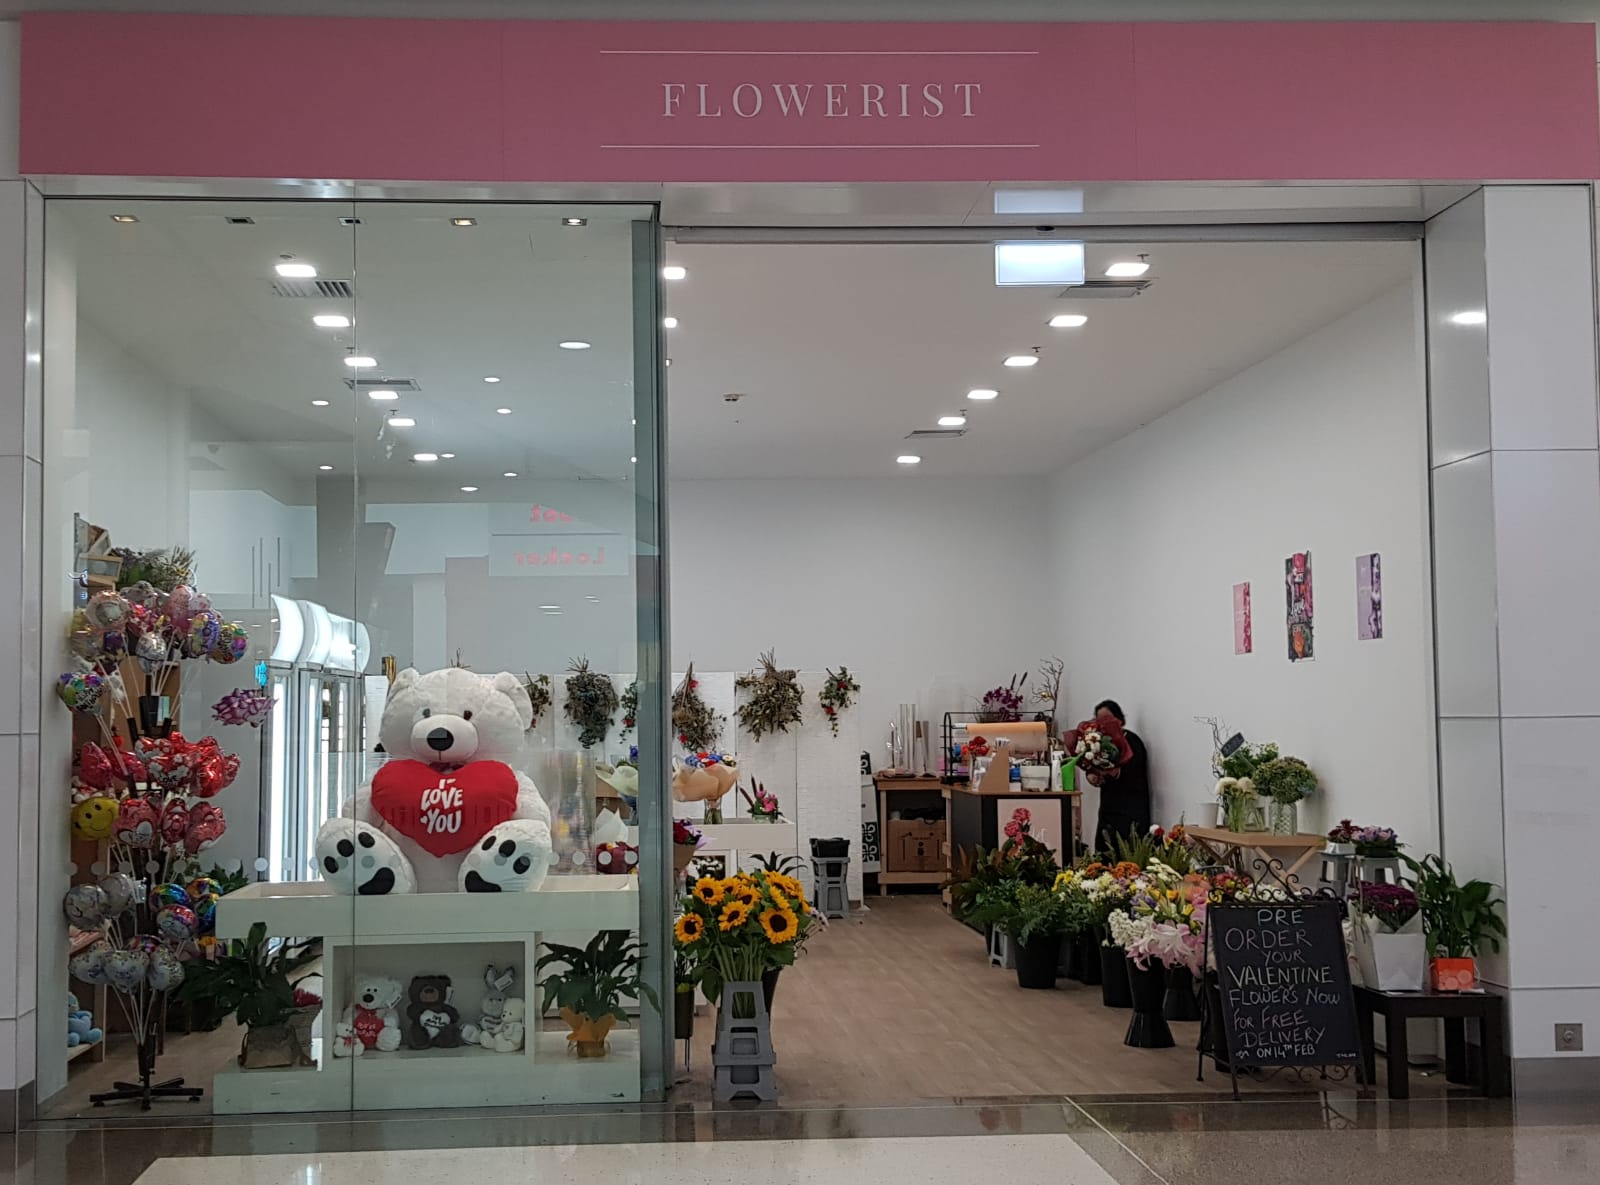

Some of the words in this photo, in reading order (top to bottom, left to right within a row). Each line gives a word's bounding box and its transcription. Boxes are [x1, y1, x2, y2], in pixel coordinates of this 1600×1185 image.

[661, 83, 982, 118] FLOWERIST
[420, 787, 464, 811] LOVE
[426, 808, 462, 834] YOU
[1257, 908, 1304, 926] PRE
[1225, 927, 1312, 951] ORDER
[1261, 950, 1306, 967] YOUR
[1227, 965, 1335, 989] VALENTINE
[1261, 1005, 1308, 1030] FREE
[1238, 1027, 1326, 1048] DELIVERY
[1256, 1047, 1272, 1058] ON
[1294, 1043, 1316, 1057] FEB
